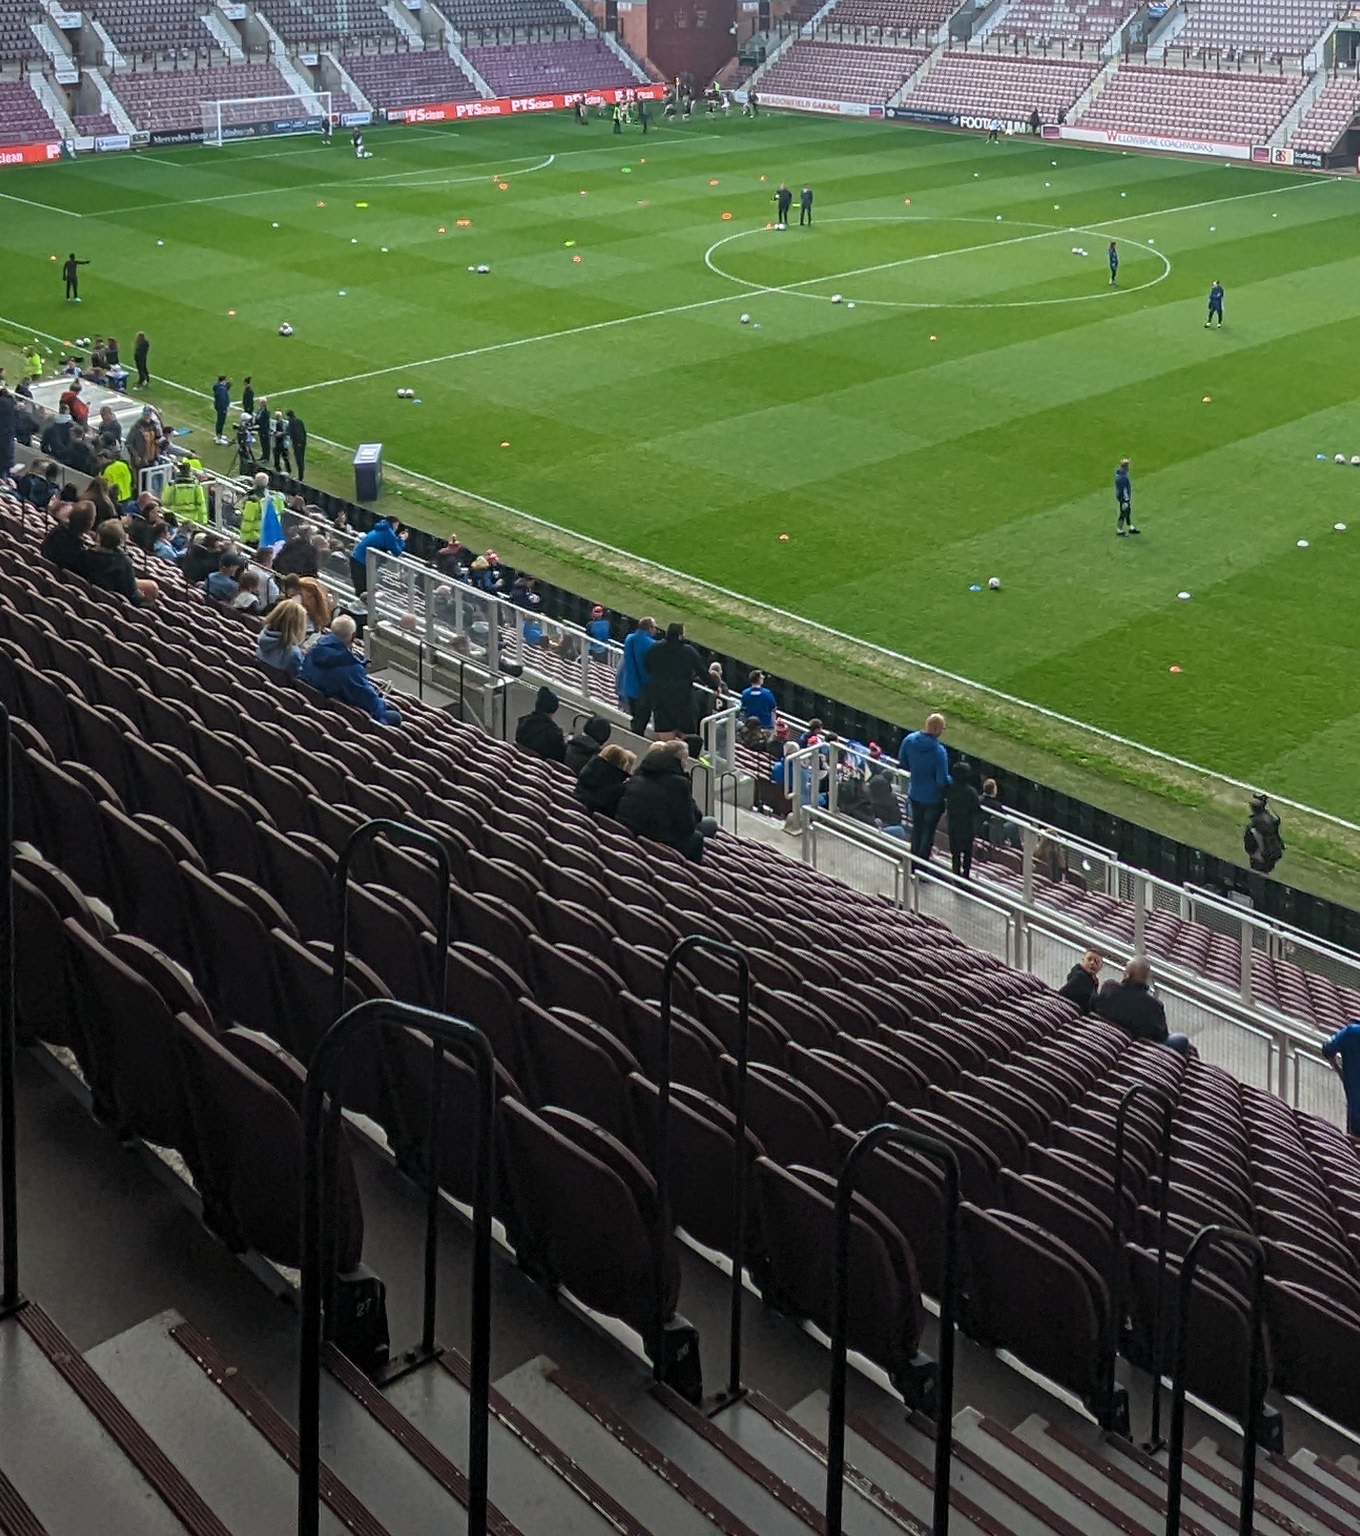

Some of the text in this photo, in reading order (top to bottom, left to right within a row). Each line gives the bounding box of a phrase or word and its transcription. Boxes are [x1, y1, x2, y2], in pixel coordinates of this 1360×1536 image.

[812, 101, 841, 112] GARAGE
[1107, 130, 1213, 152] WILLOWBRAE COACHWORKS
